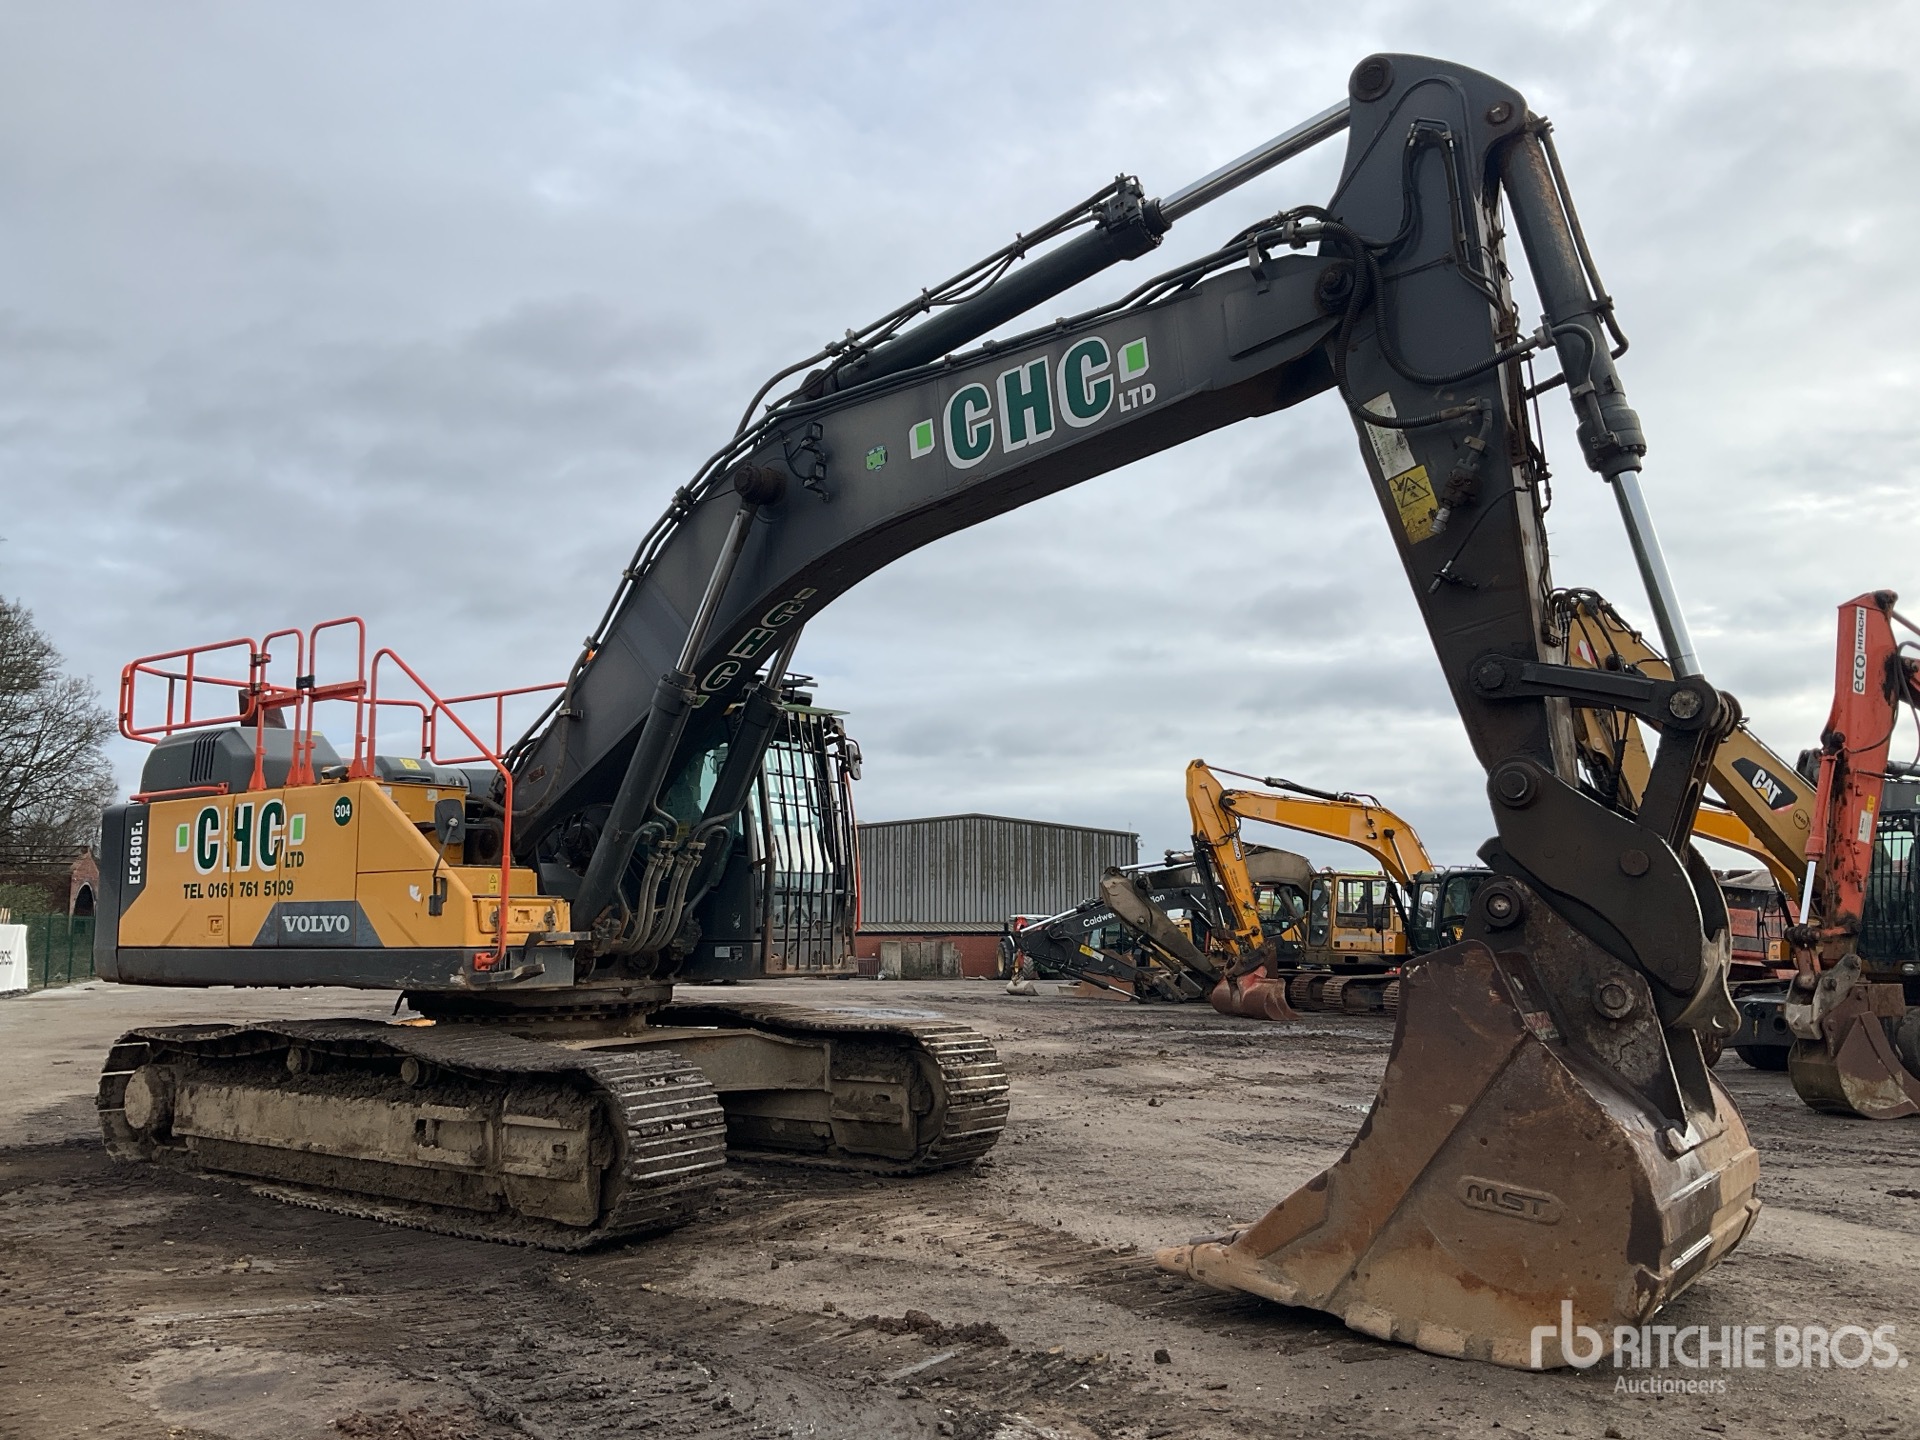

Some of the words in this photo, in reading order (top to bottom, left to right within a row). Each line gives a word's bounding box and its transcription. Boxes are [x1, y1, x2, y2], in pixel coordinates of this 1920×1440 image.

[943, 336, 1115, 470] CHC
[1118, 383, 1156, 413] LTD
[700, 600, 805, 692] CHC
[1857, 609, 1865, 650] HITACHI
[1752, 769, 1783, 805] CAT
[334, 804, 351, 818] 304
[194, 799, 287, 875] CHC
[285, 851, 304, 868] LTD
[183, 883, 204, 899] TEL
[208, 882, 234, 898] 0161
[239, 881, 259, 897] 761
[263, 880, 294, 896] 5109
[282, 915, 350, 932] VOLVO
